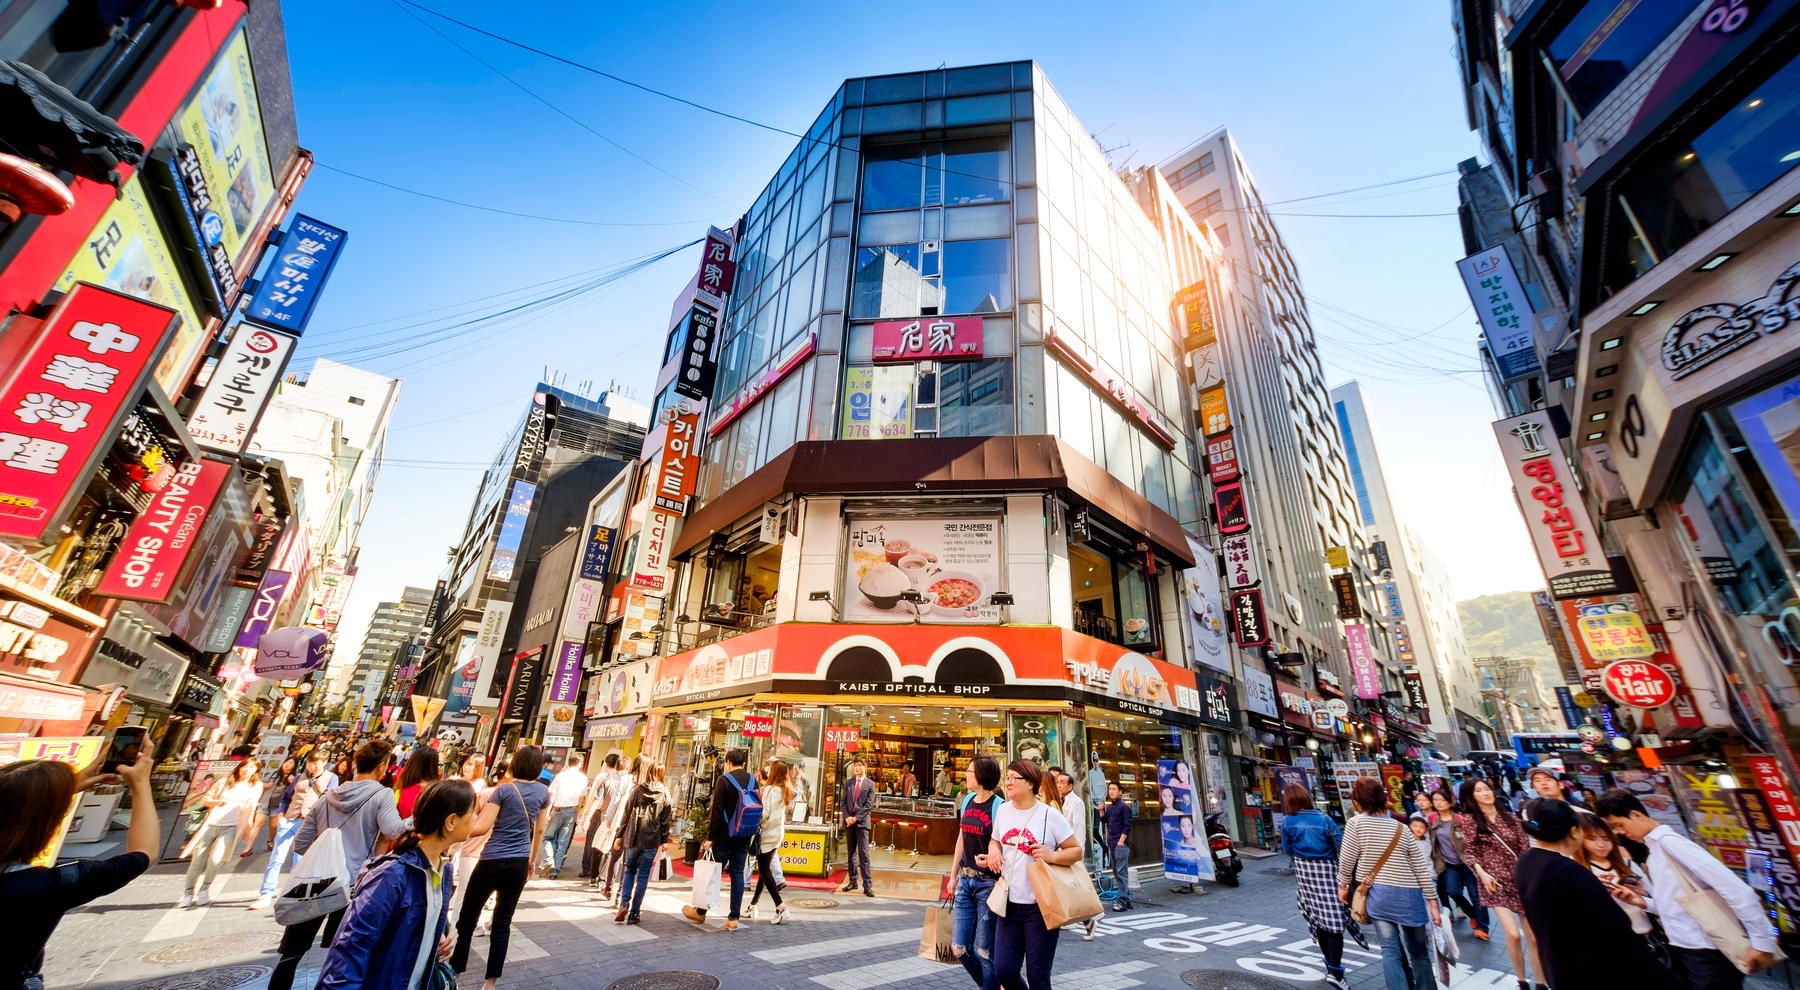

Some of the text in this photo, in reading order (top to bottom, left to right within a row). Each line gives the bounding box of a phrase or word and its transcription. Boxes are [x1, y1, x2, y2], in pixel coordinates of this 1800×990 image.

[1480, 275, 1520, 328] 반지대학
[899, 319, 955, 355] 名家
[1506, 336, 1529, 350] 4F
[1662, 313, 1755, 371] GLASS
[515, 406, 545, 471] SKYPARK
[661, 419, 693, 496] 카이스트
[148, 461, 202, 534] BEAUTY
[1522, 458, 1585, 557] 영양센타
[594, 527, 610, 542] 足
[647, 513, 668, 569] 디디치킨
[120, 536, 164, 589] SHOP
[594, 543, 610, 574] 마사지
[244, 584, 283, 633] VDL
[1241, 594, 1259, 642] 김밥천국
[262, 648, 300, 659] VDL
[1588, 627, 1646, 647] 부동산
[557, 643, 580, 701] Holika Holika
[1350, 627, 1373, 696] PINK MART
[1617, 664, 1650, 676] 공지
[511, 662, 534, 719] ARITAUM
[838, 683, 990, 694] KAIST OPTICAL SHOP
[1118, 664, 1168, 703] KAIST
[1613, 677, 1665, 698] Hair
[744, 719, 757, 734] Big
[757, 720, 773, 733] Sale
[1119, 701, 1164, 717] OPTICAL SHOP
[826, 729, 859, 742] SALE
[800, 839, 821, 851] Lens
